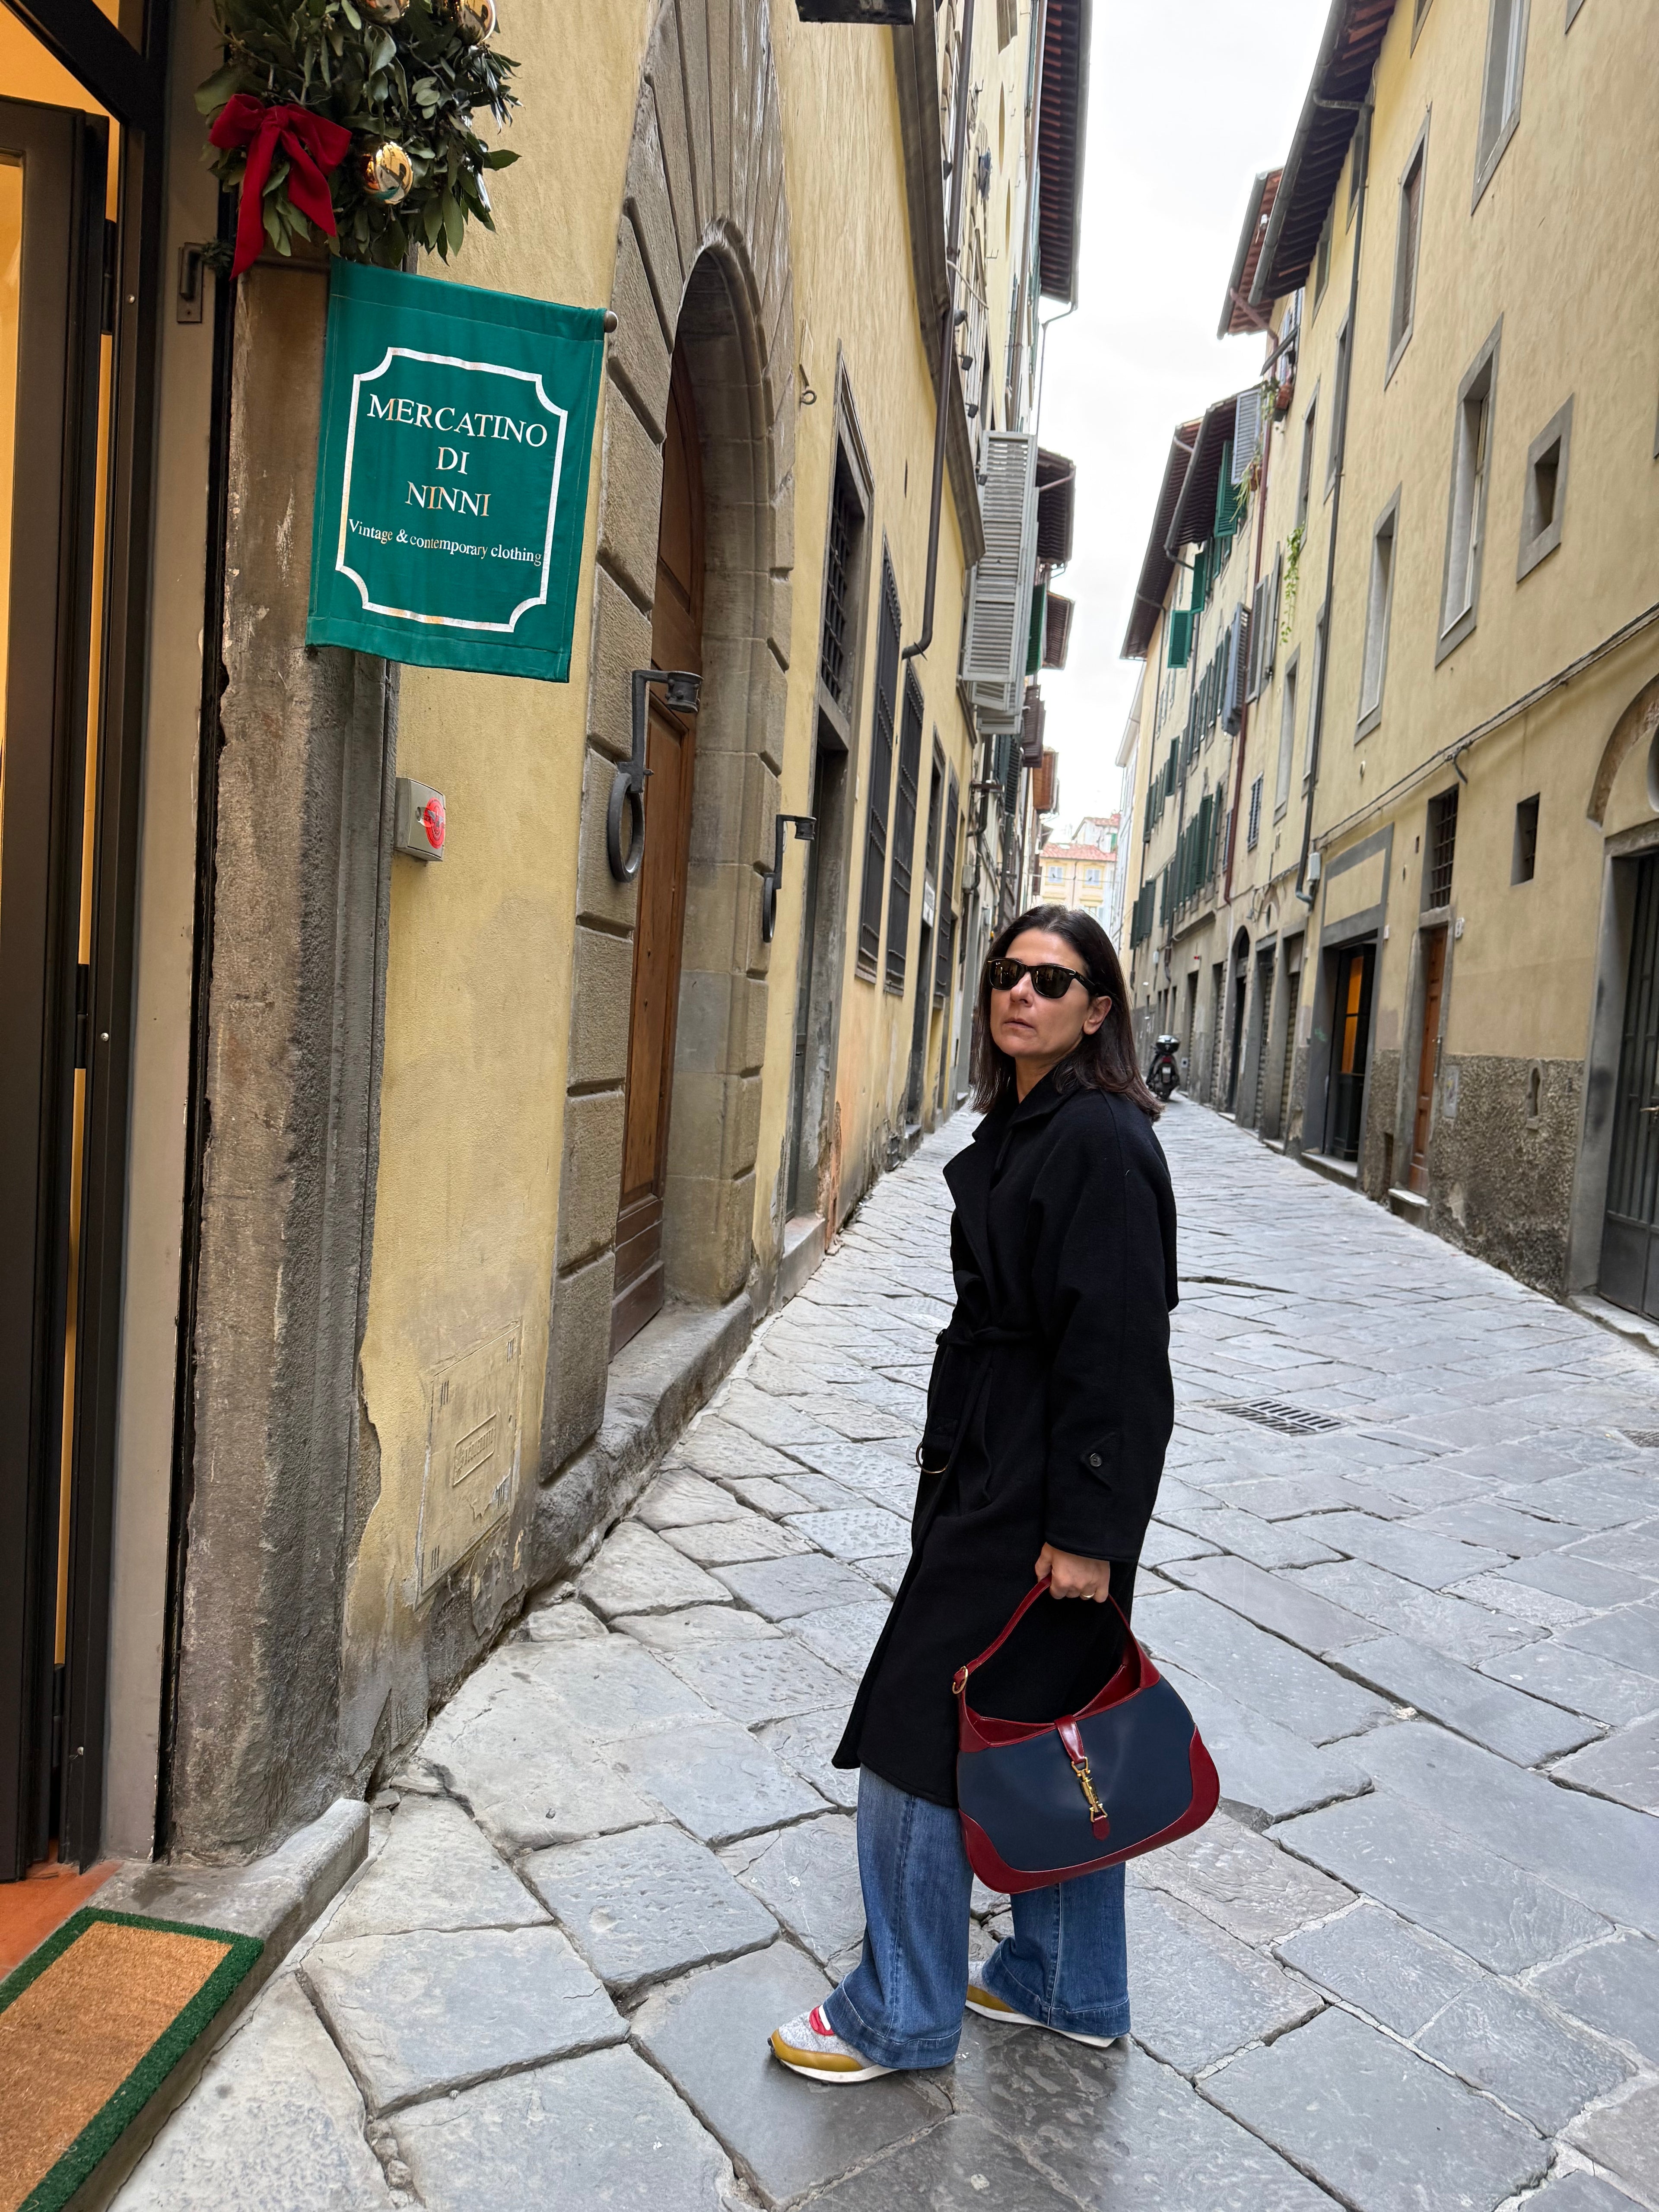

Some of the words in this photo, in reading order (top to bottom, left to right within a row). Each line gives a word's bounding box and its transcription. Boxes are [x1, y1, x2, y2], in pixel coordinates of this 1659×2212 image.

[367, 394, 547, 447] MERCATINO
[435, 447, 470, 474] DI
[405, 481, 491, 516] NINNI
[349, 519, 393, 544] Vintage
[397, 529, 408, 543] &
[410, 536, 488, 559] contemporary
[491, 545, 542, 566] clothing
